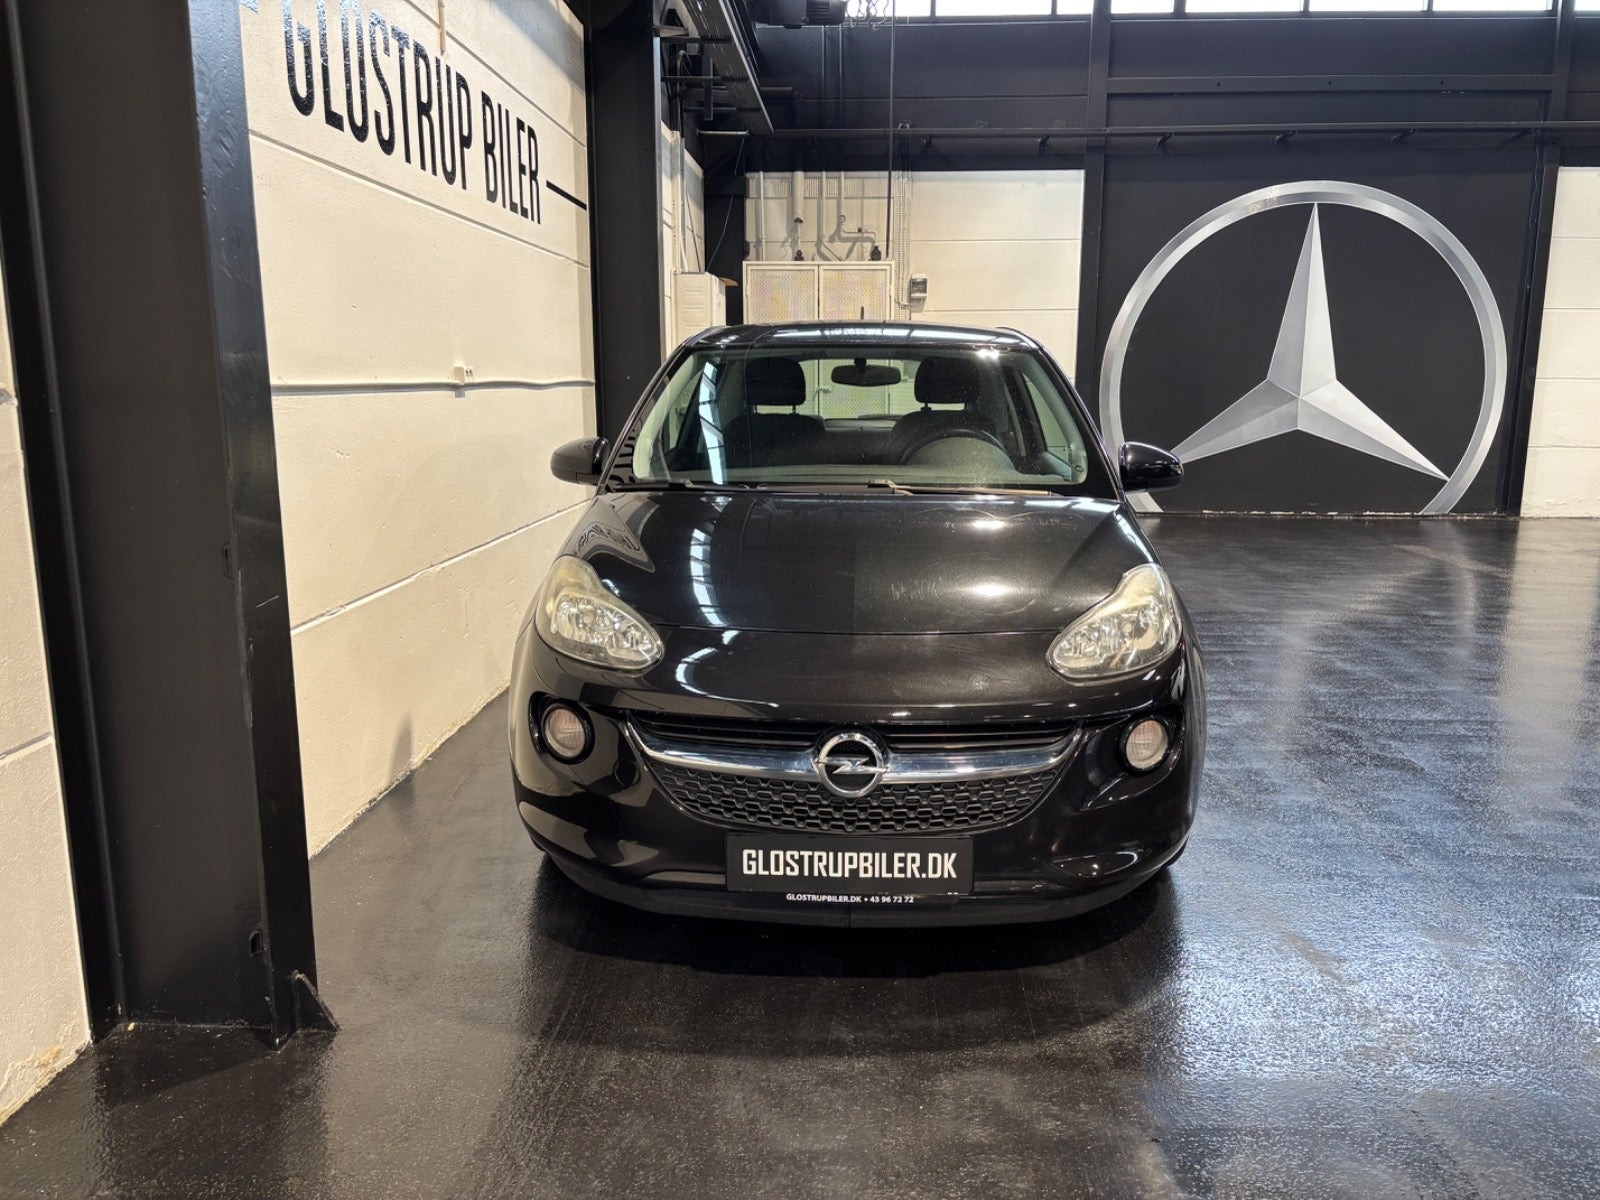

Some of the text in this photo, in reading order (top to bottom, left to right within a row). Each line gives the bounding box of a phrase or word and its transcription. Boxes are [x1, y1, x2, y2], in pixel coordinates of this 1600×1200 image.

[282, 0, 542, 225] GLOSTRUP BILER
[742, 849, 958, 879] GLOSTRUPBILER.DK
[785, 893, 914, 904] GLOSTRUPBILER.DK 43 96 72 72
